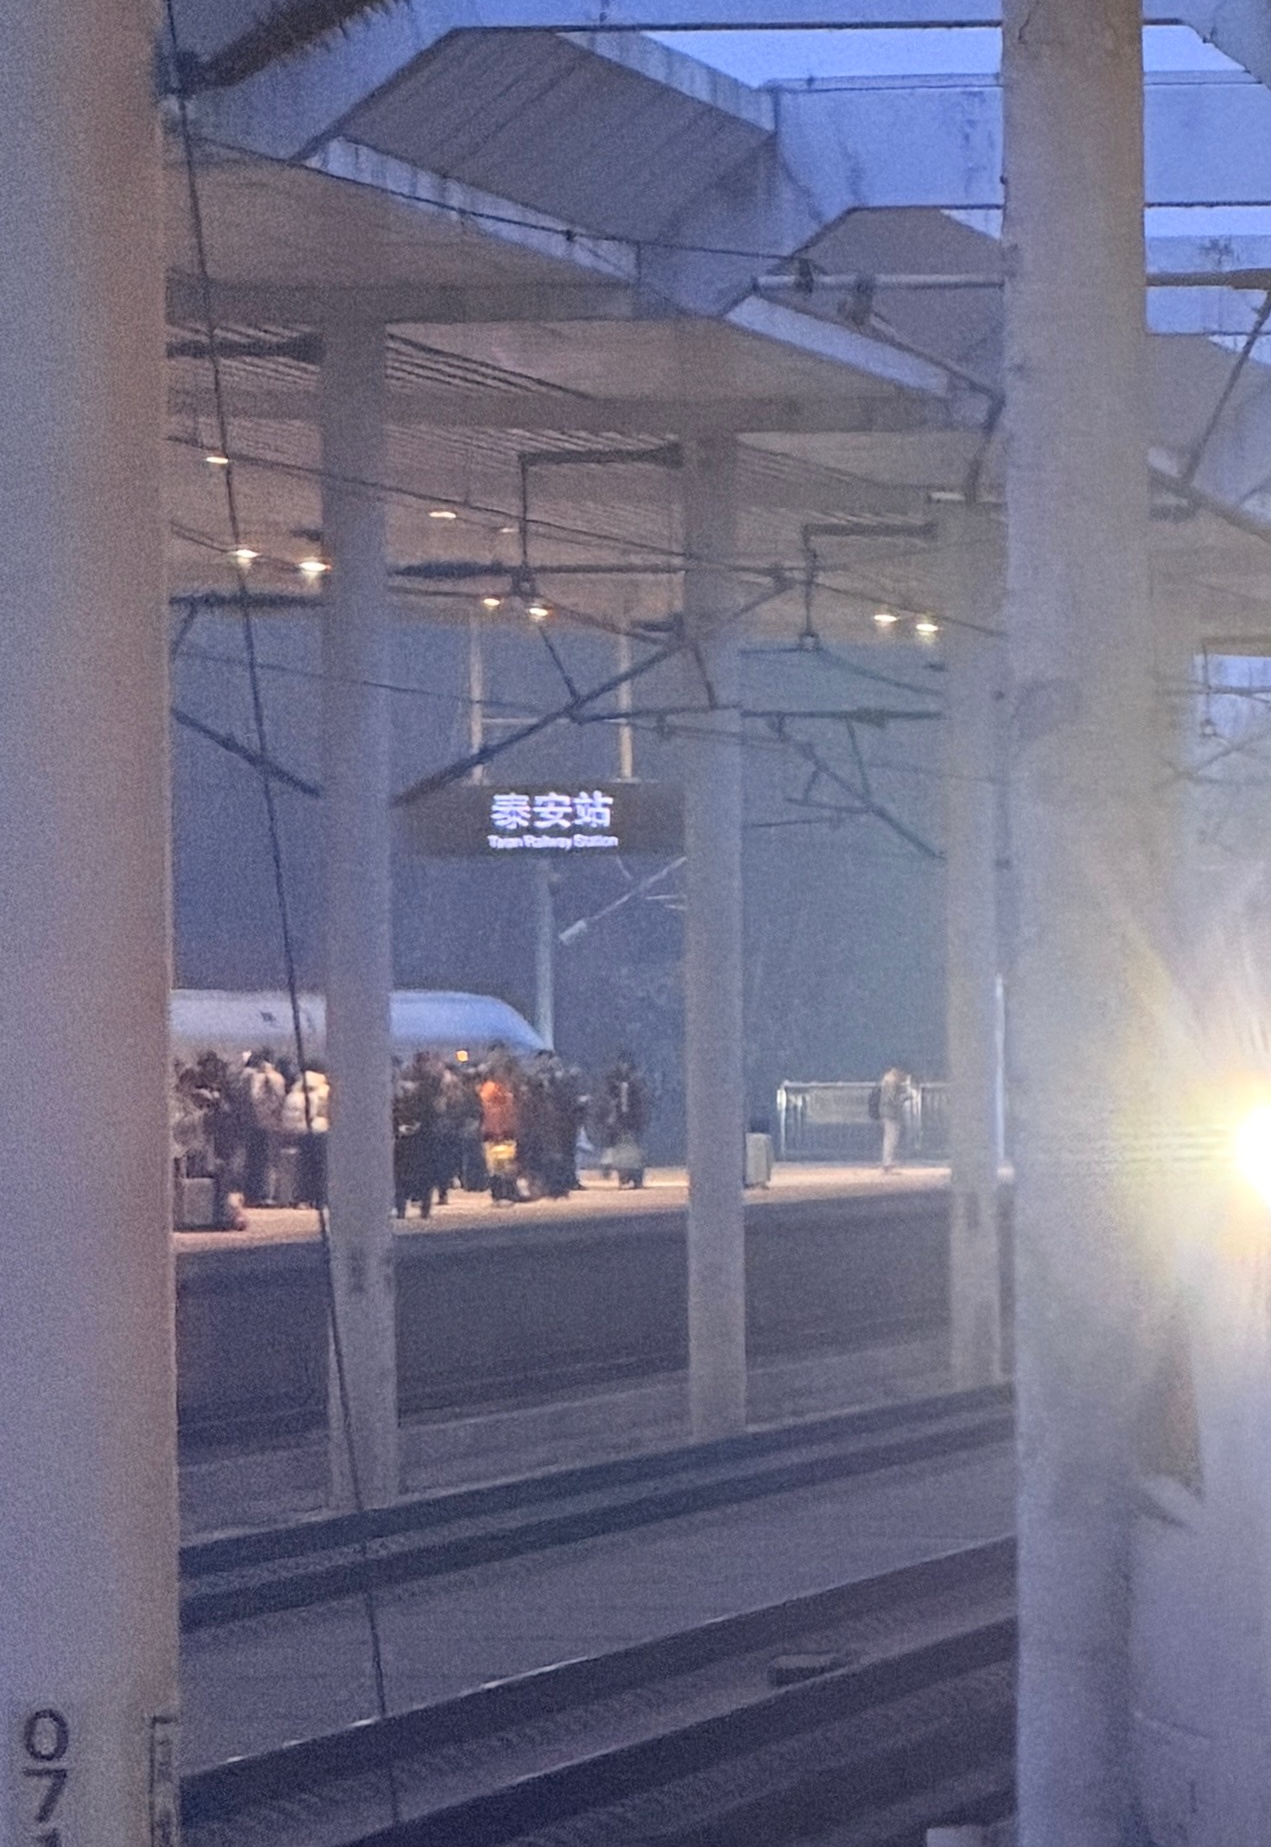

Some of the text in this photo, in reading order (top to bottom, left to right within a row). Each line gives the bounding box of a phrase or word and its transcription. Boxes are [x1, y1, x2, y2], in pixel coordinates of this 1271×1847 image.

[490, 791, 614, 830] 泰安站
[573, 834, 619, 848] Station
